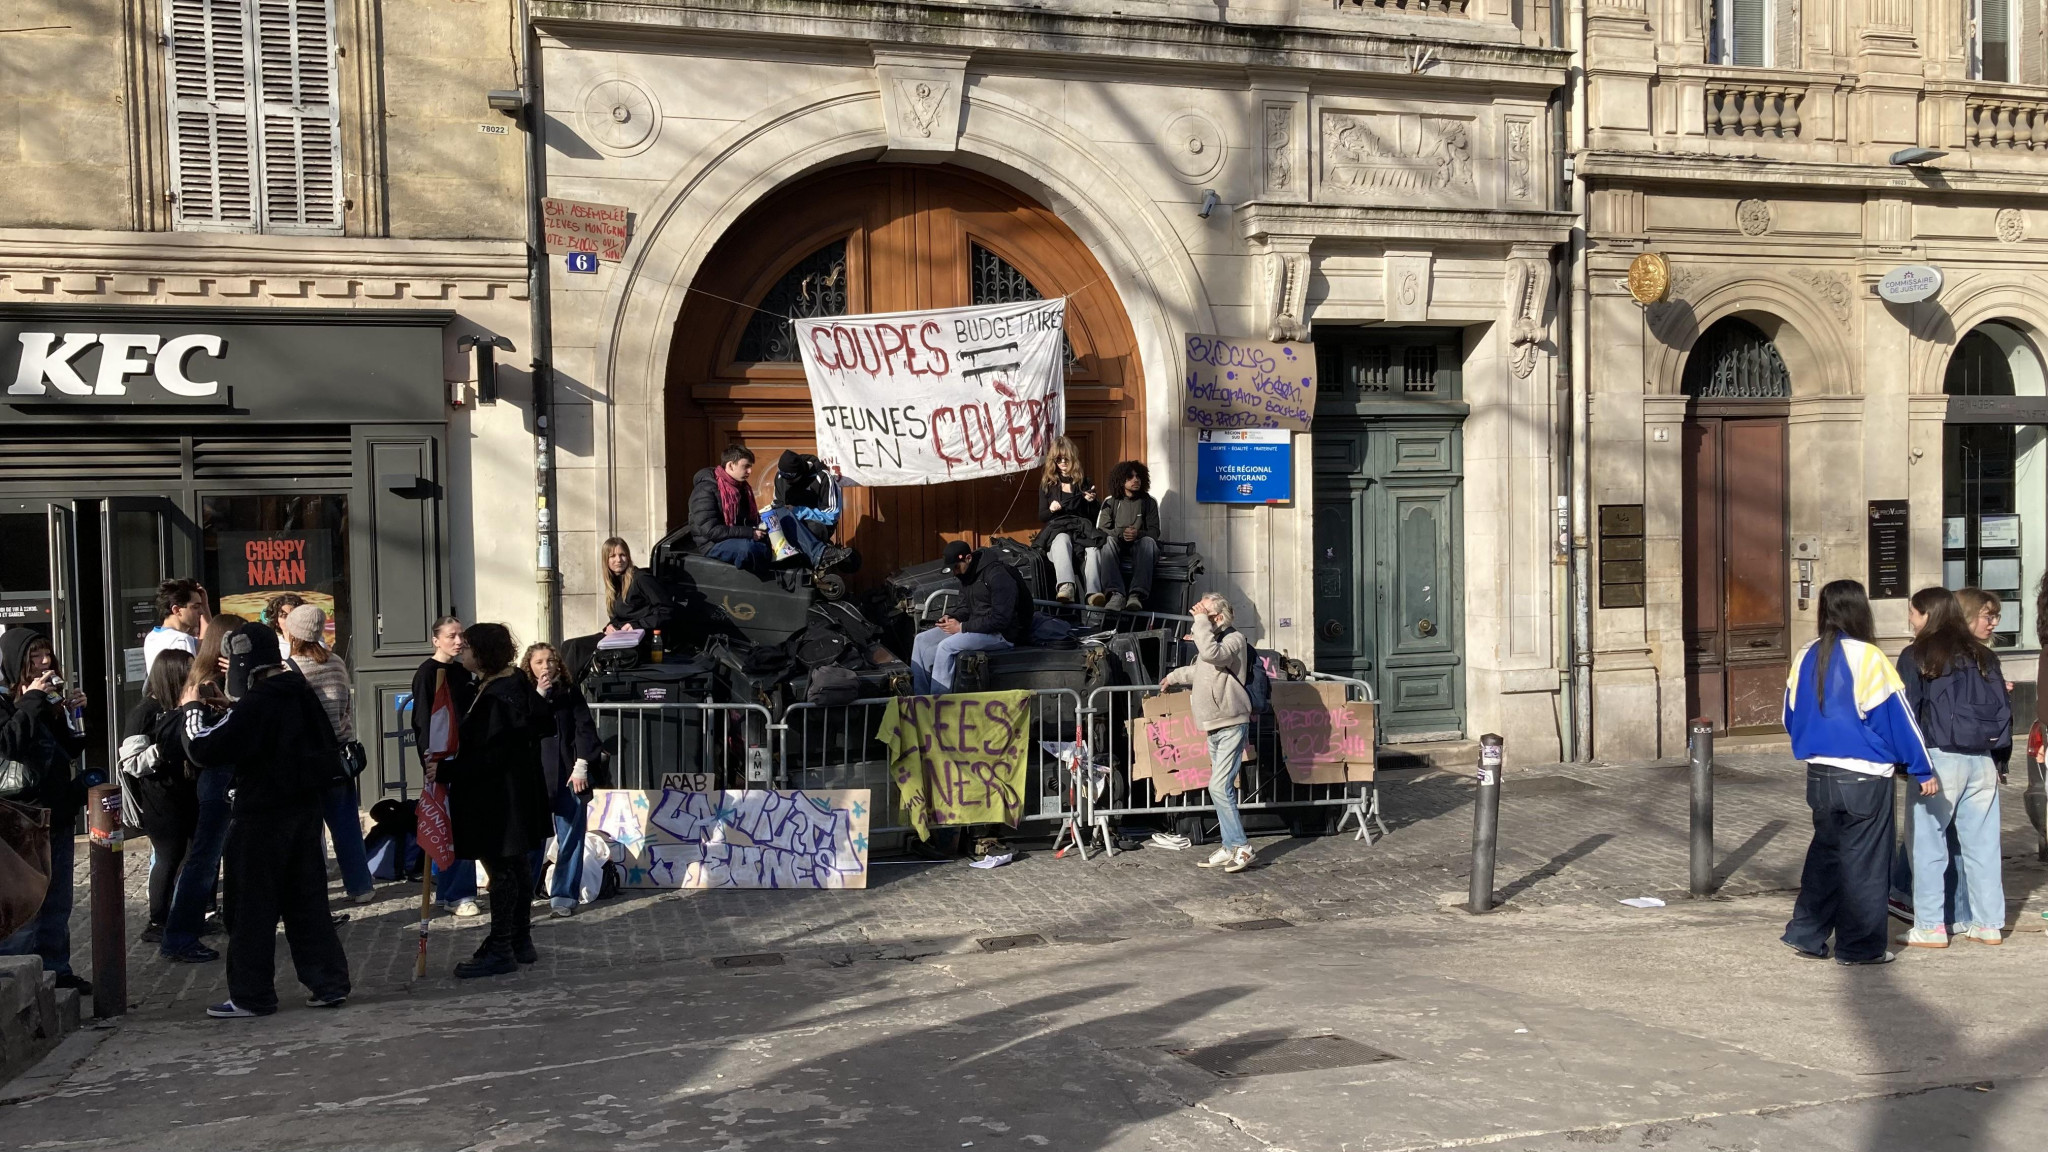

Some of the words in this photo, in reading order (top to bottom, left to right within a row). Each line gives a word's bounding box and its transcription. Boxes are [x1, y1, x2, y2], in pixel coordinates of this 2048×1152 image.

[481, 125, 505, 133] 78022
[545, 232, 567, 246] OTE:
[566, 235, 599, 252] BLOCUS
[575, 254, 588, 271] 6
[1885, 276, 1934, 289] COMMISSAIRE
[1900, 284, 1929, 293] JUSTICE
[810, 318, 951, 380] COUPES
[1187, 336, 1277, 374] BLOCUS
[7, 332, 222, 397] KFC
[821, 405, 928, 440] JEUNES
[854, 438, 902, 469] EN
[1215, 464, 1236, 473] LYCÉE
[1236, 464, 1272, 473] RÉGIONAL
[1219, 474, 1267, 482] MONTGRAND
[245, 537, 306, 561] CRISPY
[248, 559, 306, 586] NAAN
[662, 773, 707, 792] ACAB
